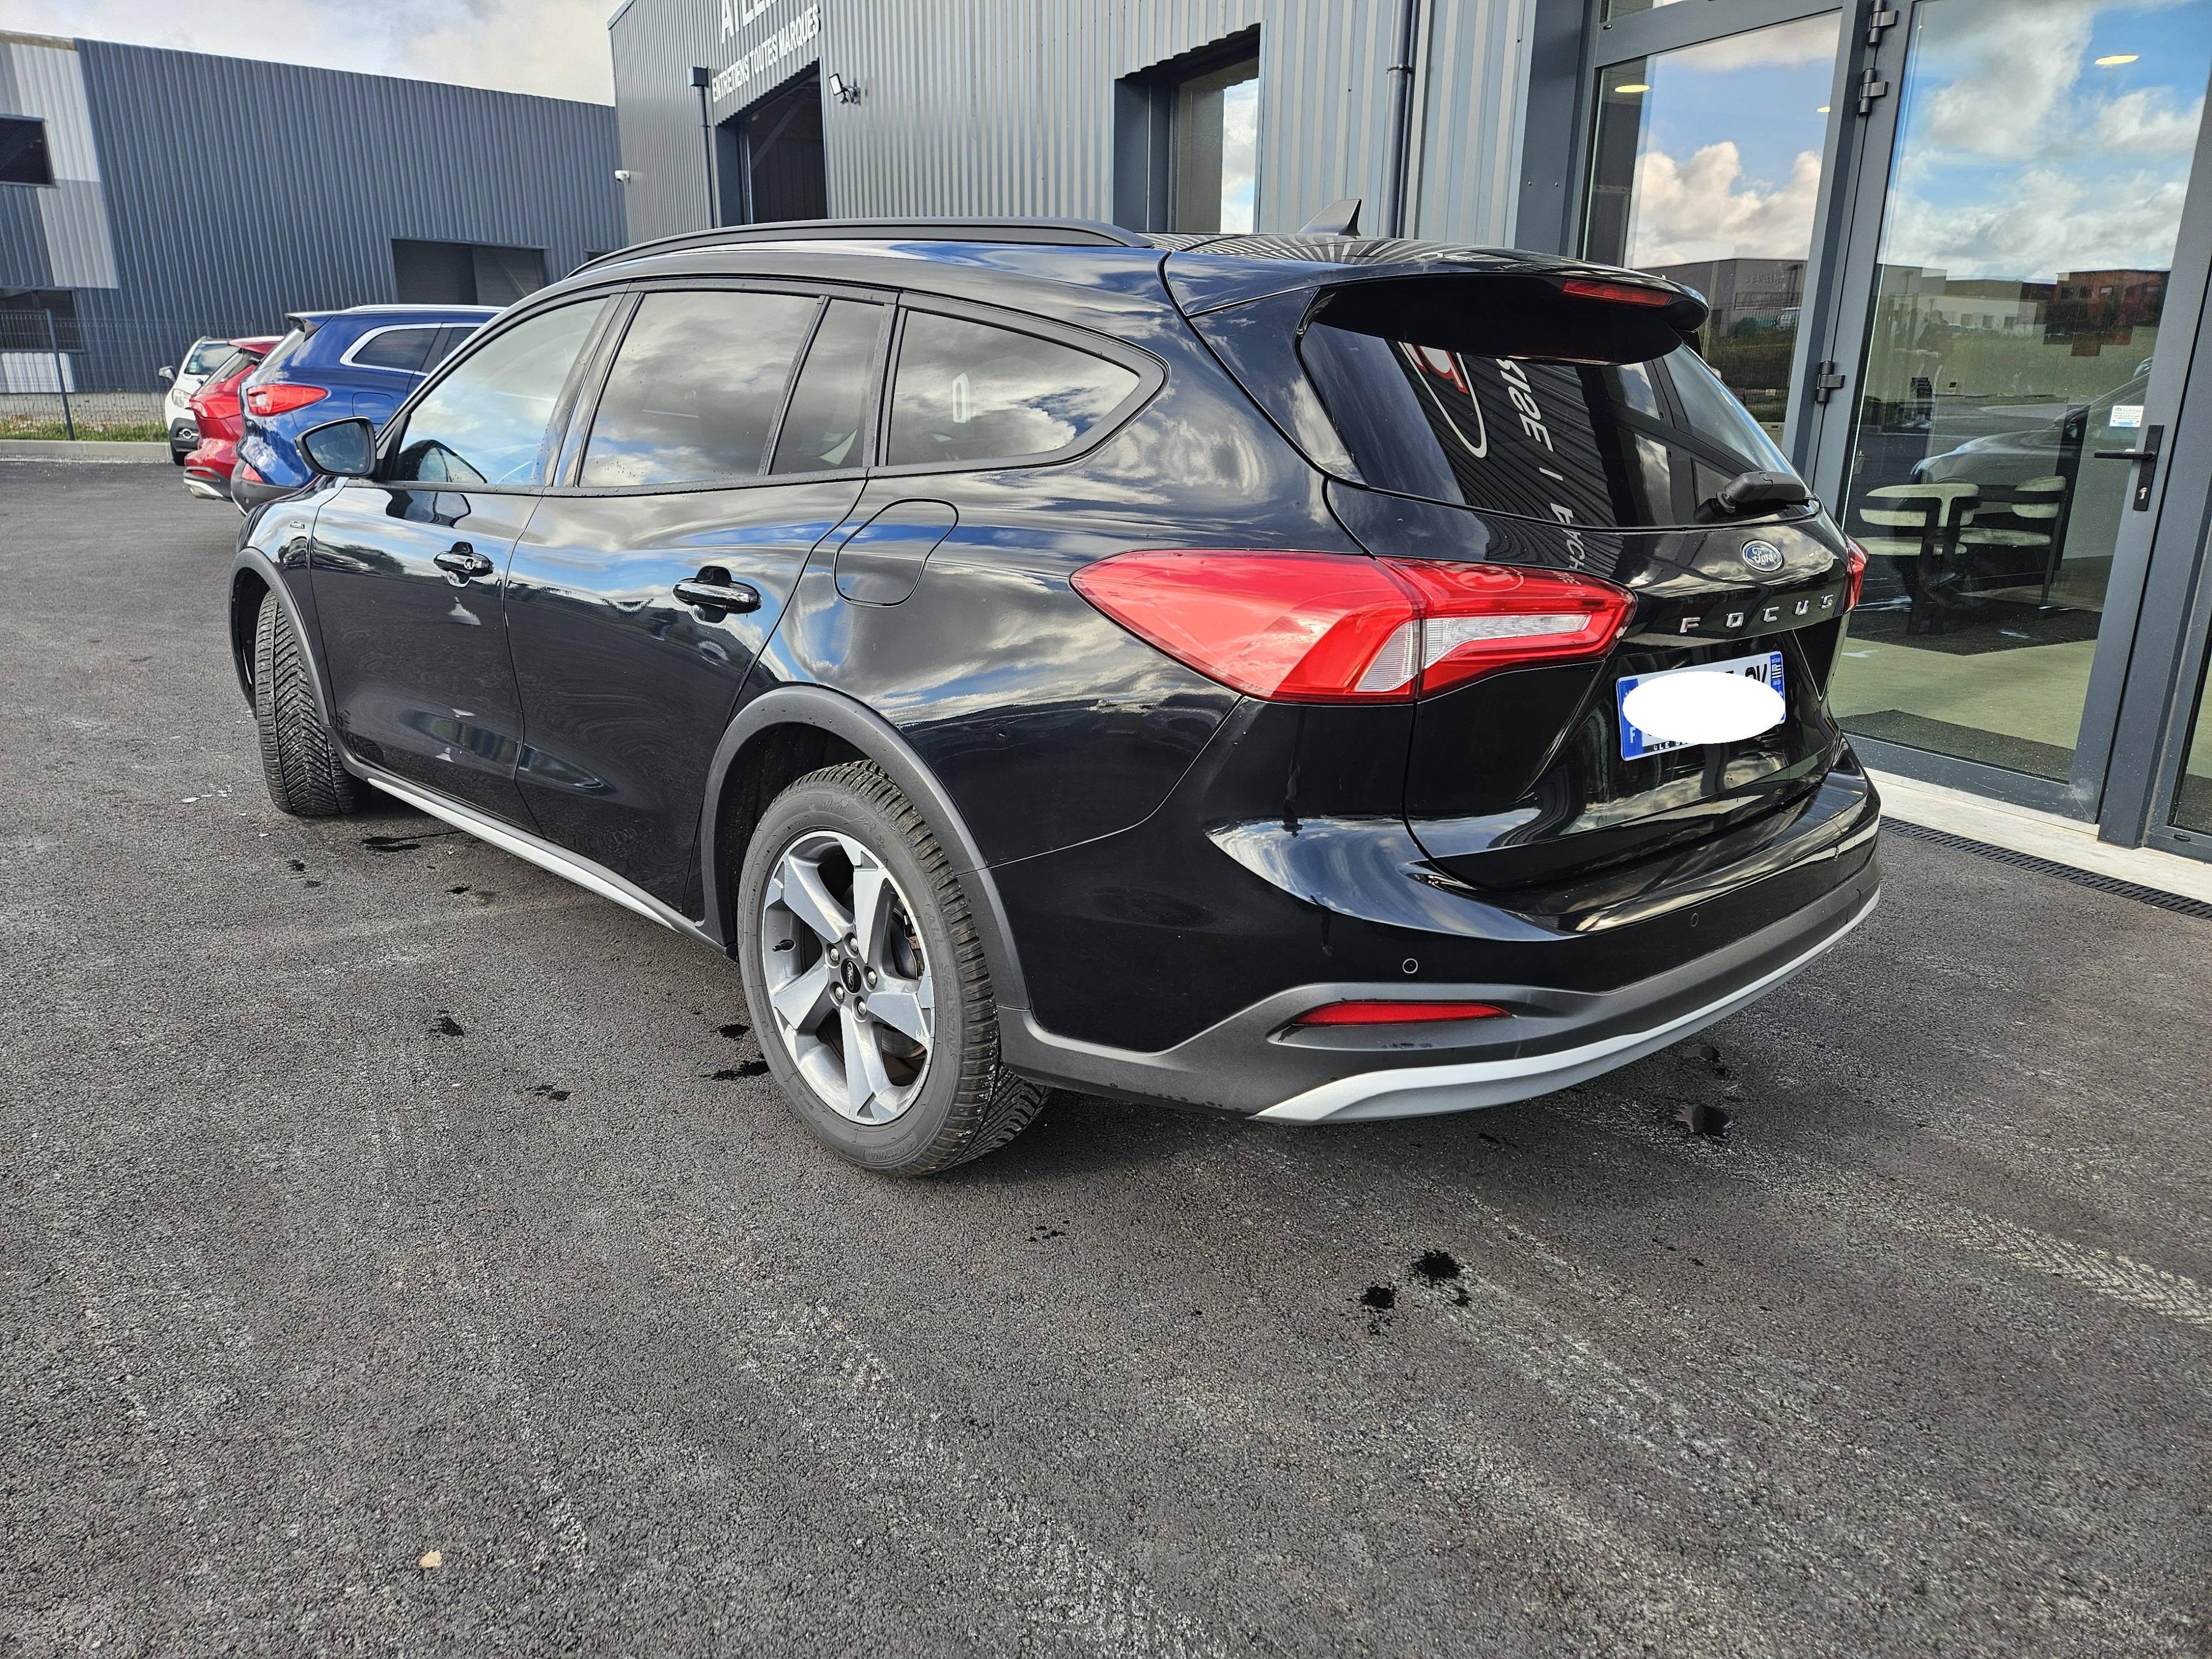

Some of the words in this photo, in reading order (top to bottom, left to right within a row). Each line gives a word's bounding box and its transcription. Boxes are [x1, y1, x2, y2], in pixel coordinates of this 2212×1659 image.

[711, 55, 749, 103] ENTRETIENS
[749, 33, 778, 77] TOUTES
[778, 3, 821, 59] MARQUES
[1679, 594, 1835, 633] FOCUS
[1630, 726, 1636, 744] F
